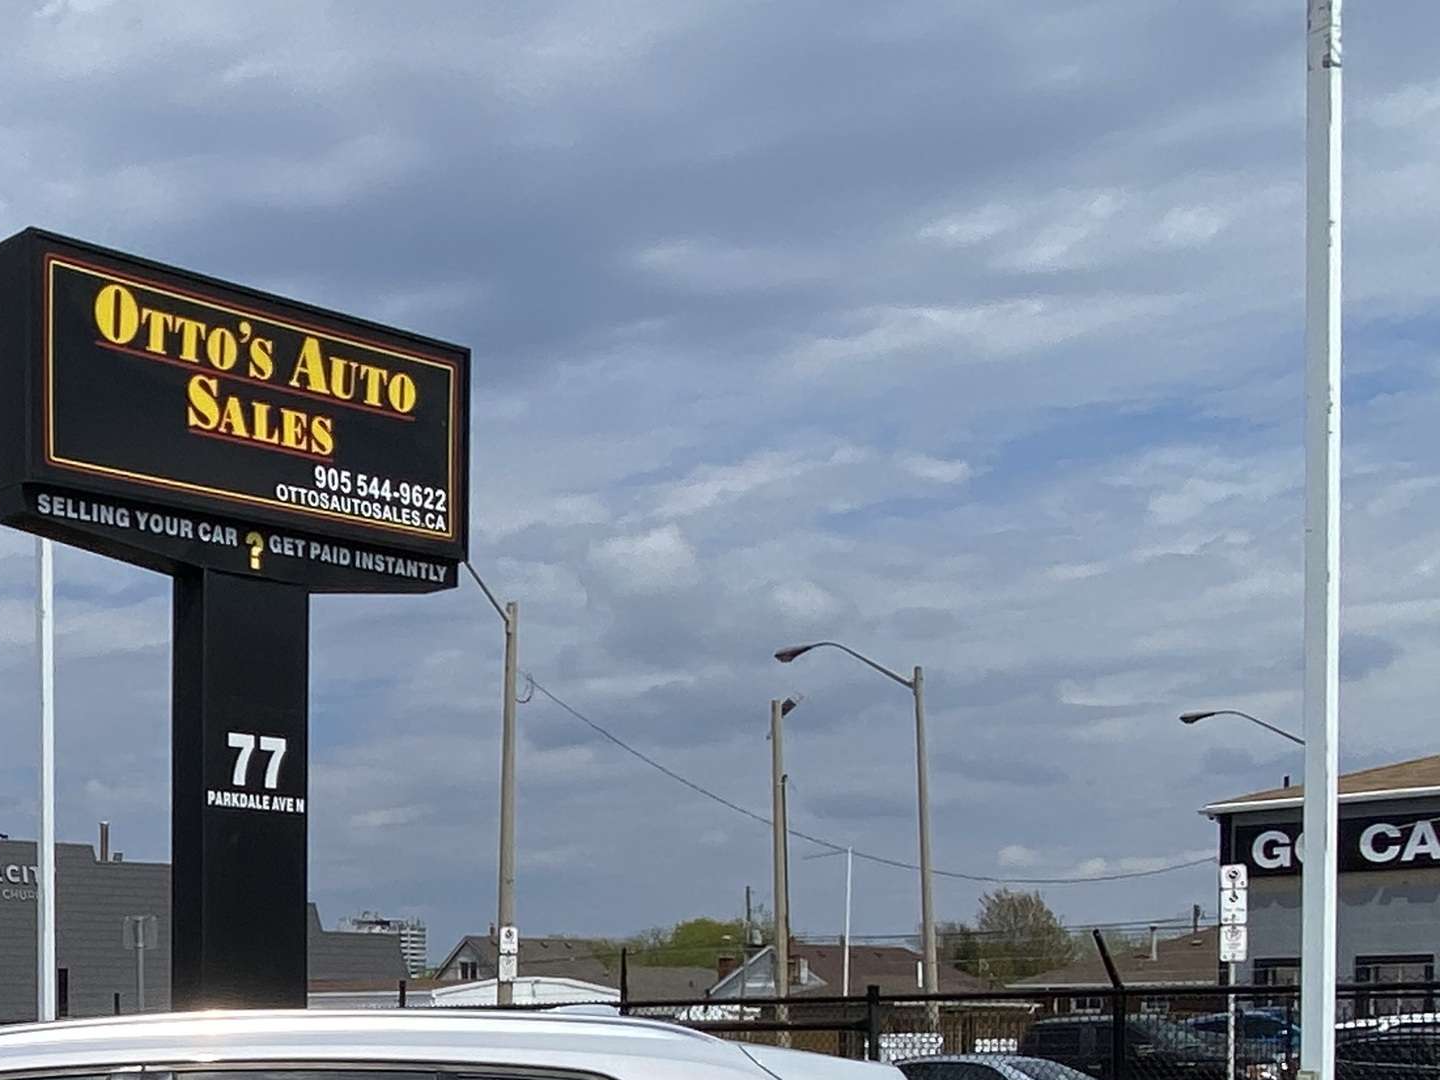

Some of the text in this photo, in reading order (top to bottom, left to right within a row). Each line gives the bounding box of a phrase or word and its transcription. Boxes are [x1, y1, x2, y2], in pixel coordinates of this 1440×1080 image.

[94, 284, 417, 414] OTTO'S AUTO
[188, 374, 334, 456] SALES
[276, 484, 447, 532] OTTOSAUTOSALES.CA
[314, 465, 447, 512] 905 544-9622
[37, 494, 130, 528] SELLING
[134, 510, 193, 539] YOUR
[198, 522, 238, 547] CAR
[269, 535, 307, 558] GET
[310, 541, 351, 566] PAID
[355, 550, 448, 583] INSTANTLY
[228, 731, 287, 789] 77
[207, 790, 305, 813] PARKDALE AVE N
